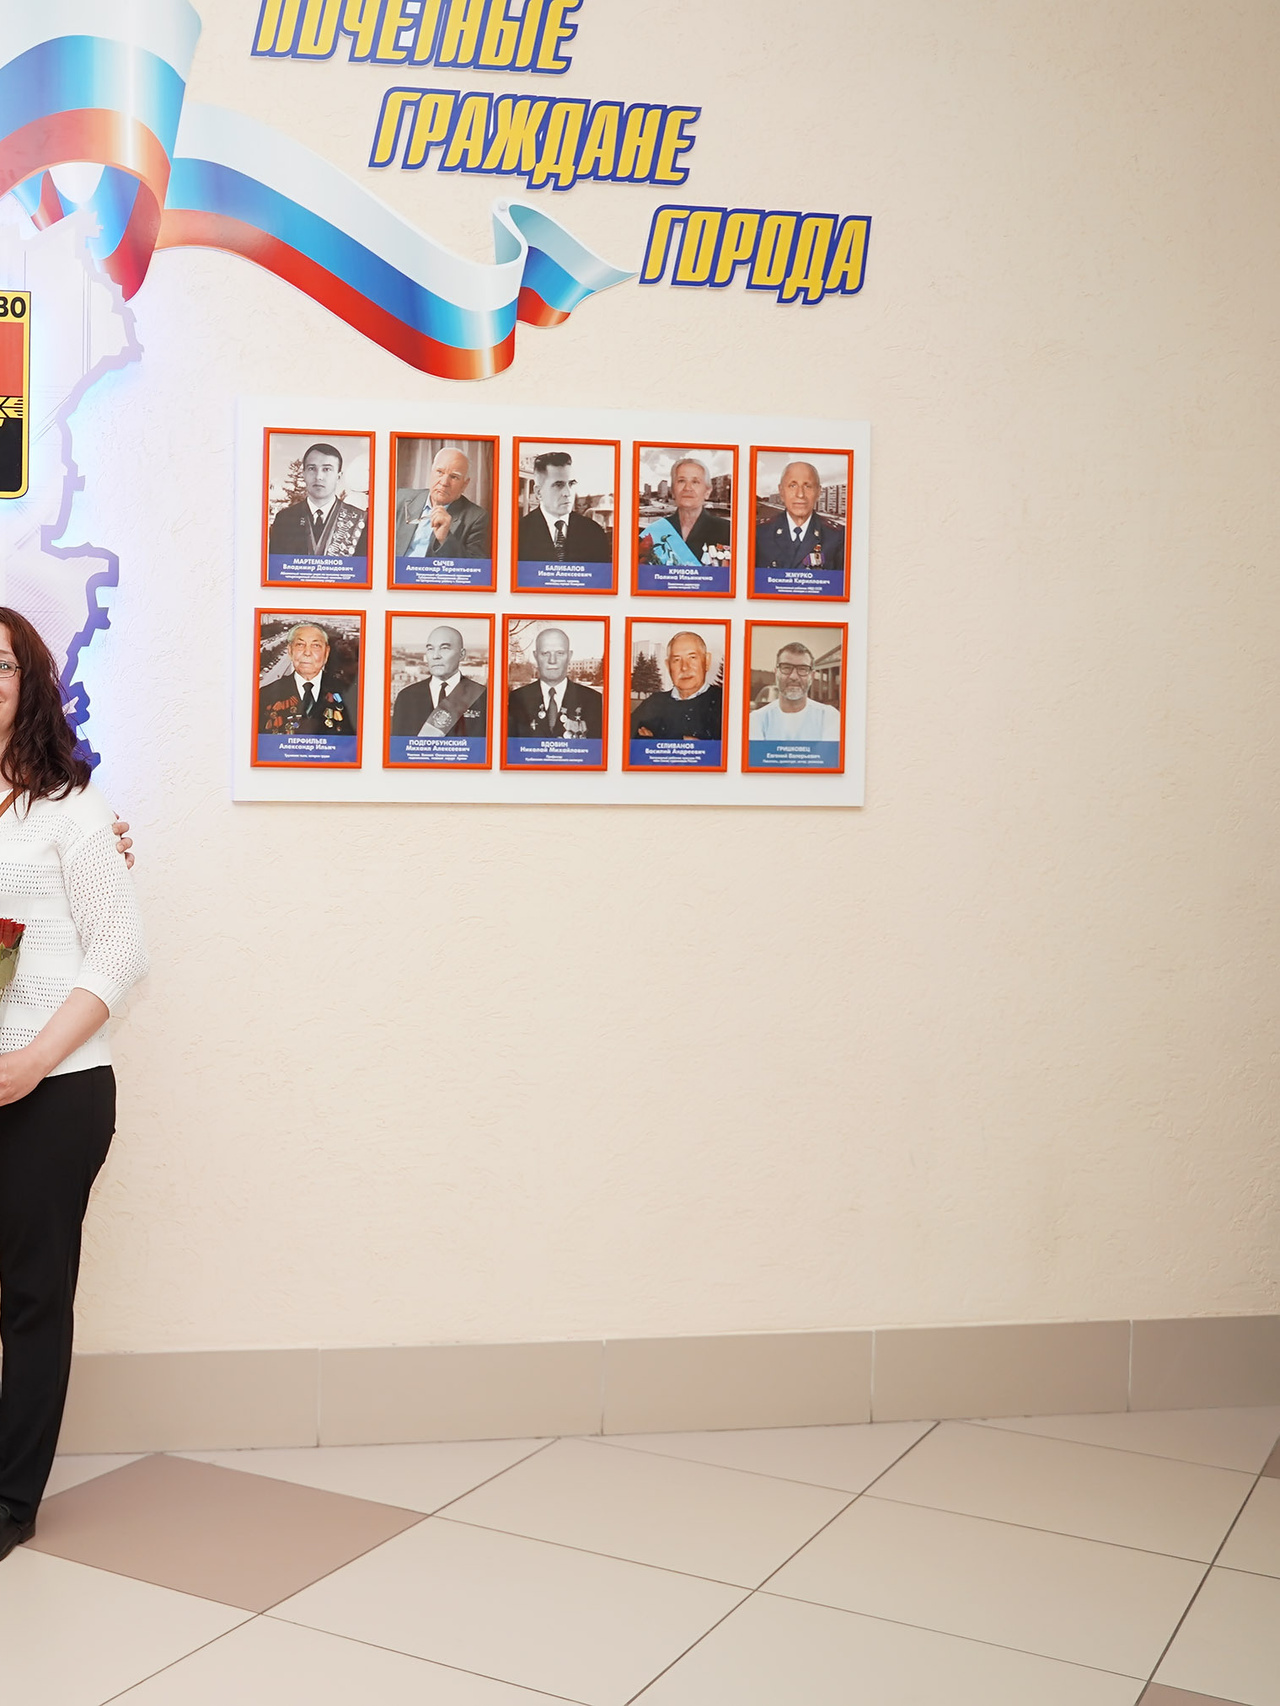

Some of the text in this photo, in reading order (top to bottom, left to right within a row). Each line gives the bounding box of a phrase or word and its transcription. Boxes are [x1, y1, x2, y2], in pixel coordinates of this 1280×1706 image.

[370, 87, 700, 190] ГРАЖДАНЕ
[639, 205, 871, 304] ГОРОДА
[282, 564, 316, 572] Владимир
[406, 565, 441, 573] Александр
[279, 743, 315, 751] Александр
[409, 739, 467, 747] ПОДГОРБУНСКИЙ
